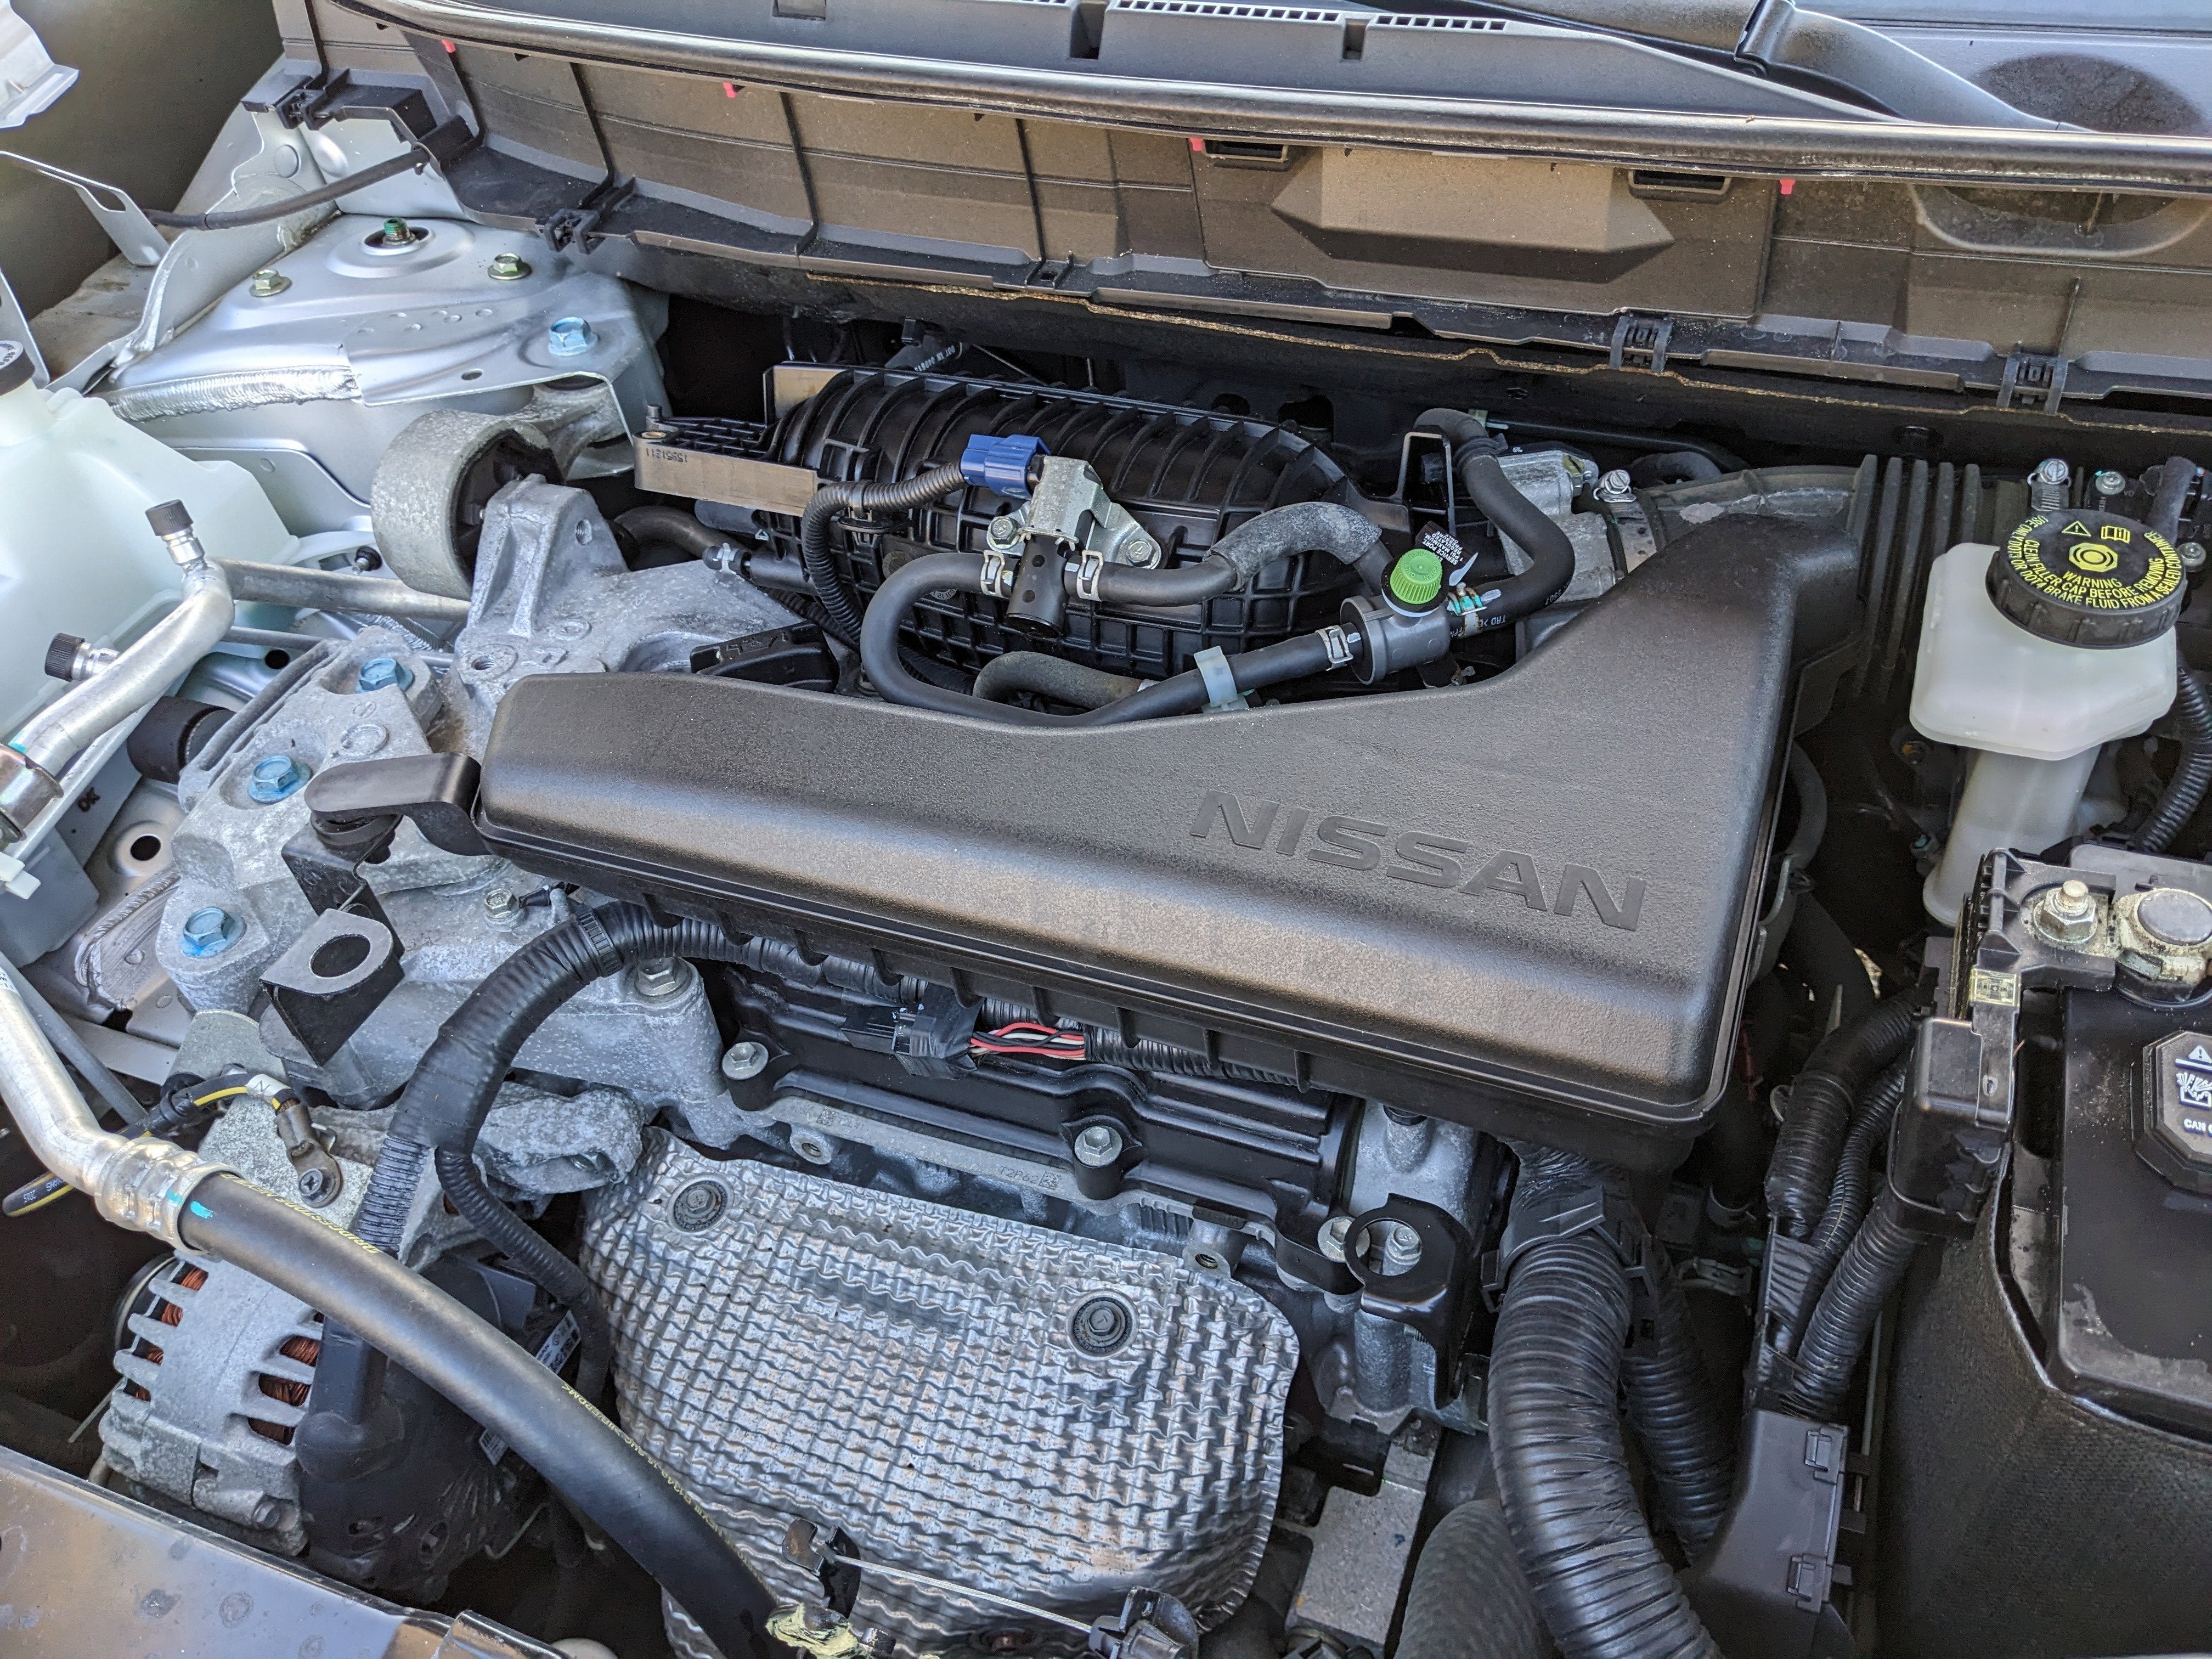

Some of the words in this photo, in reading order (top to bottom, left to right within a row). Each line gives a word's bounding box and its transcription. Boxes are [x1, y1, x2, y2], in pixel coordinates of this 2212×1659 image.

[2025, 515, 2049, 528] USE
[1436, 530, 1463, 551] PRESSURE
[2011, 524, 2033, 541] ONLY
[1431, 533, 1462, 555] REGULATED
[2007, 540, 2023, 558] DOT3
[2023, 539, 2041, 563] CLEAN
[2143, 530, 2182, 569] CONTAINER
[1435, 548, 1459, 566] SERVICE
[1449, 550, 1460, 560] PSI
[1404, 563, 1416, 578] ONLY
[1423, 561, 1439, 581] TIGHTEN
[2011, 560, 2028, 571] OR
[2029, 562, 2063, 587] FILLER
[2020, 570, 2047, 589] DOT4
[2062, 571, 2122, 589] WARNING
[2133, 557, 2165, 593] REMOVING
[2154, 569, 2182, 595] SEALED
[2044, 585, 2083, 605] BRAKE
[2062, 582, 2087, 596] CAP
[2089, 586, 2140, 599] BEFORE
[2149, 590, 2164, 600] A
[2085, 597, 2120, 609] FLUID
[2120, 592, 2156, 608] FROM
[1189, 789, 1646, 931] NISSAN
[2183, 1119, 2206, 1132] CAN
